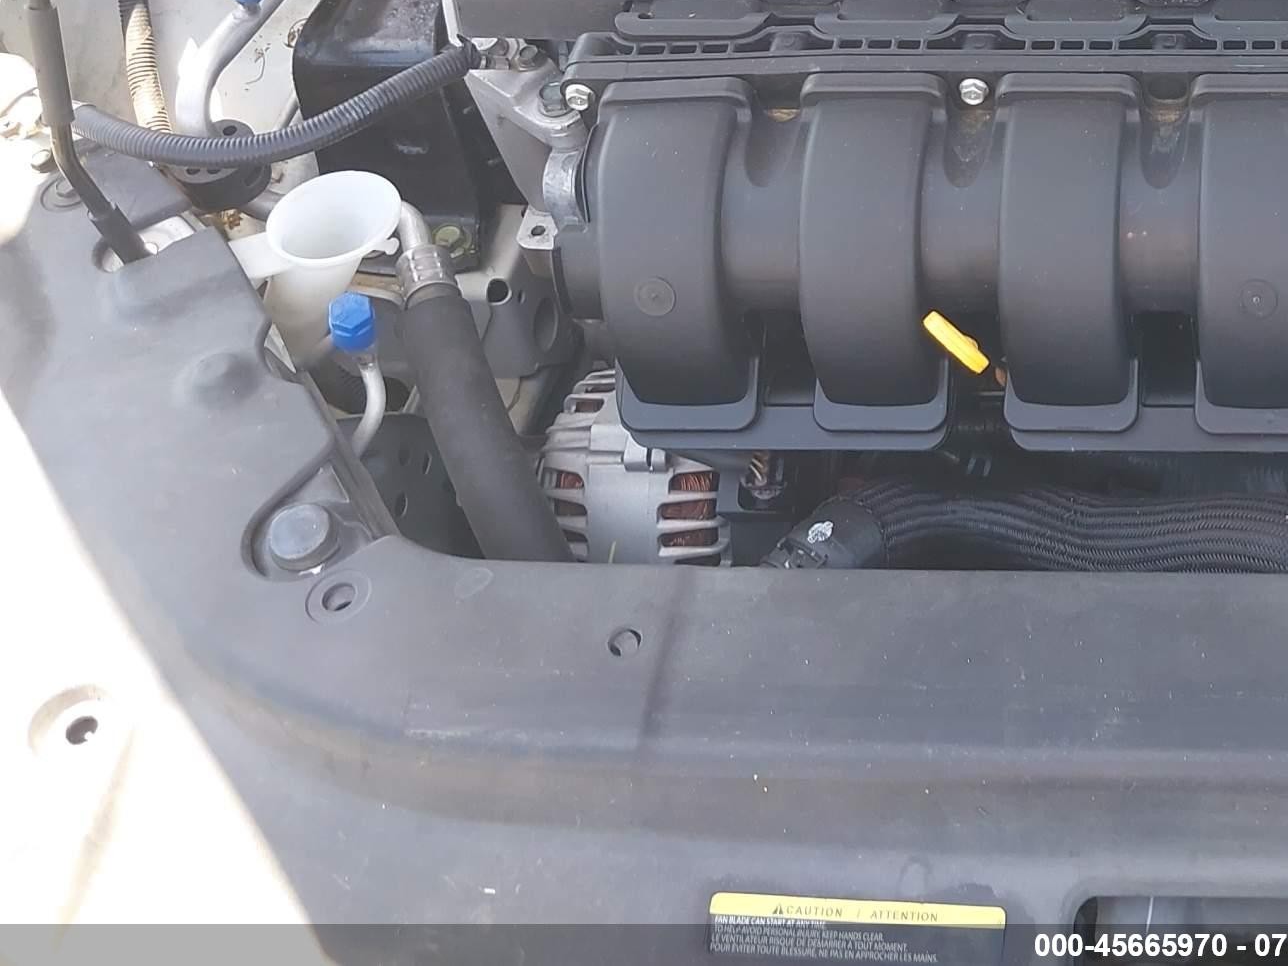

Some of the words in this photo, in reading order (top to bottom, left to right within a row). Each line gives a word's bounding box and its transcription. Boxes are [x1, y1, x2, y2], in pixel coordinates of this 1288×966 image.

[786, 905, 842, 917] CAUTION
[870, 910, 938, 922] ATTENTION
[751, 916, 765, 925] CAN
[741, 926, 762, 935] AVOID
[838, 931, 862, 940] HANDS
[854, 940, 872, 950] TOUT
[855, 951, 898, 961] APPROCHER
[899, 952, 913, 962] LES
